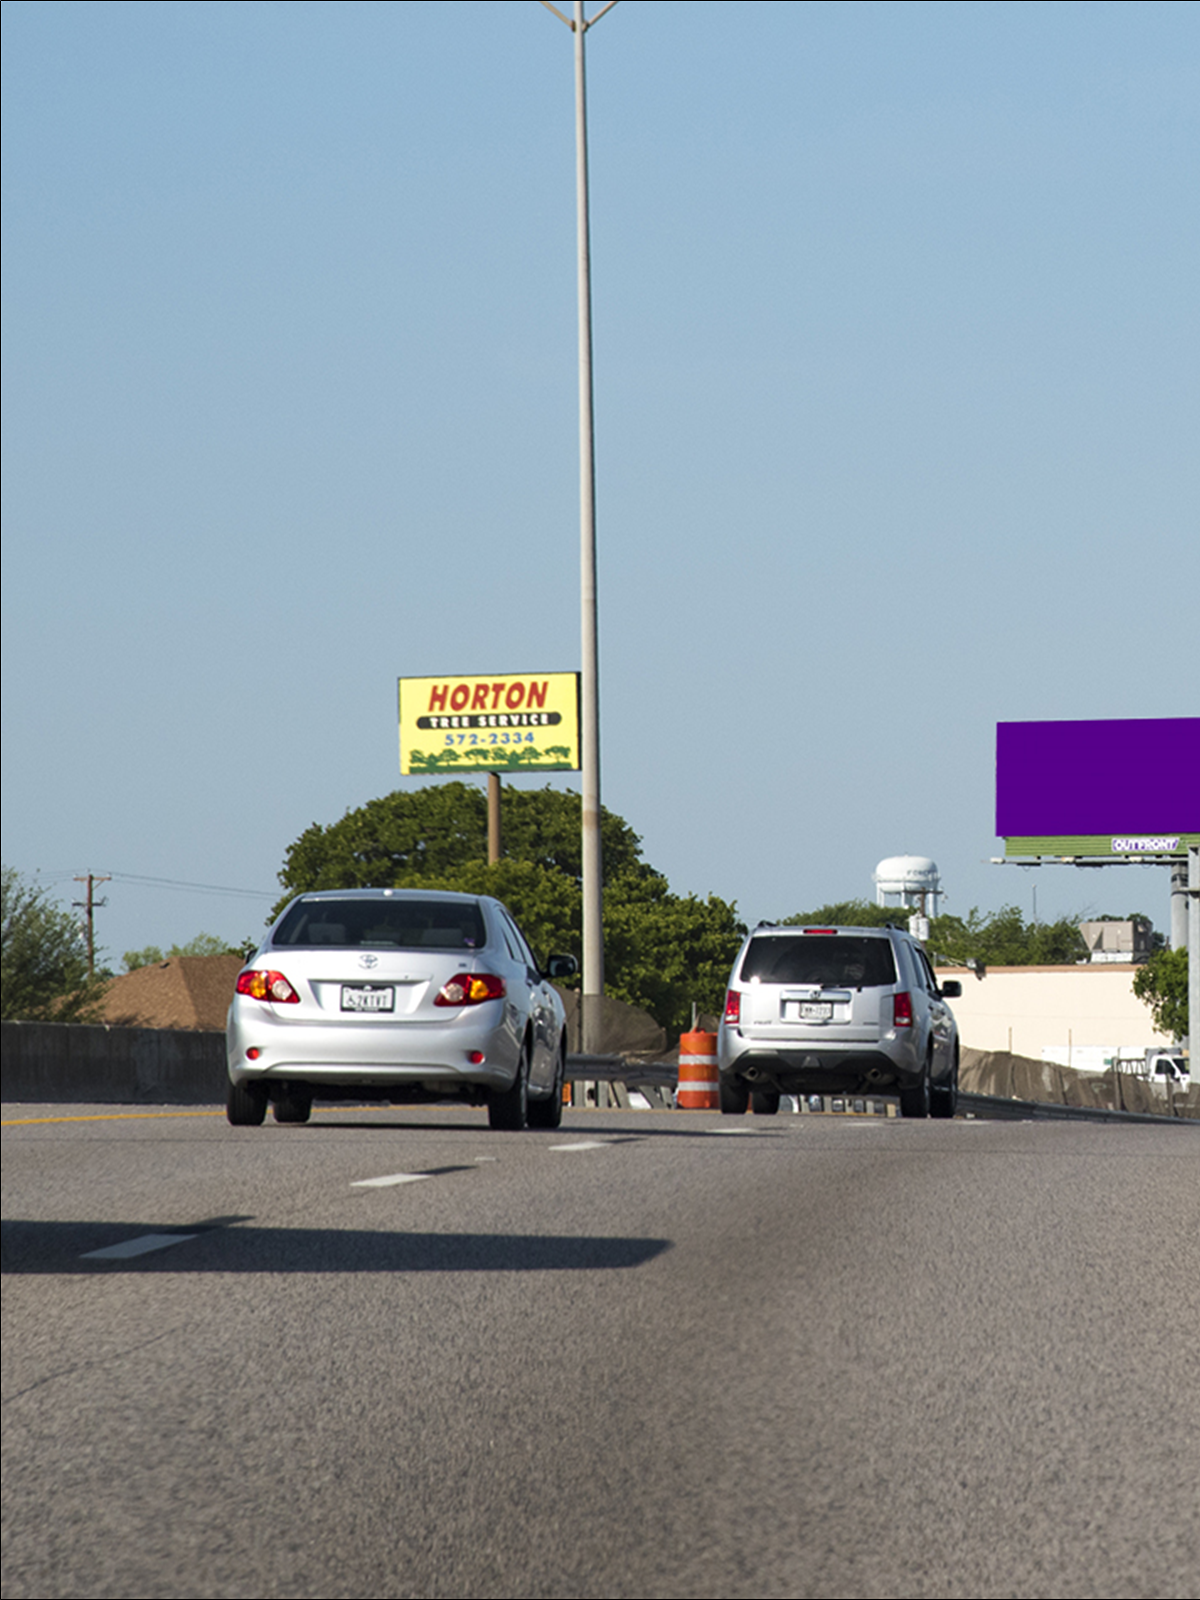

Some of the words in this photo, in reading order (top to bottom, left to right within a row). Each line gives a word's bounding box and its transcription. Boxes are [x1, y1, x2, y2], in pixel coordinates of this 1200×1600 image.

[428, 681, 549, 712] HORTON
[429, 715, 470, 729] TREE
[477, 713, 549, 727] SERVICE
[444, 732, 535, 746] 572-2334
